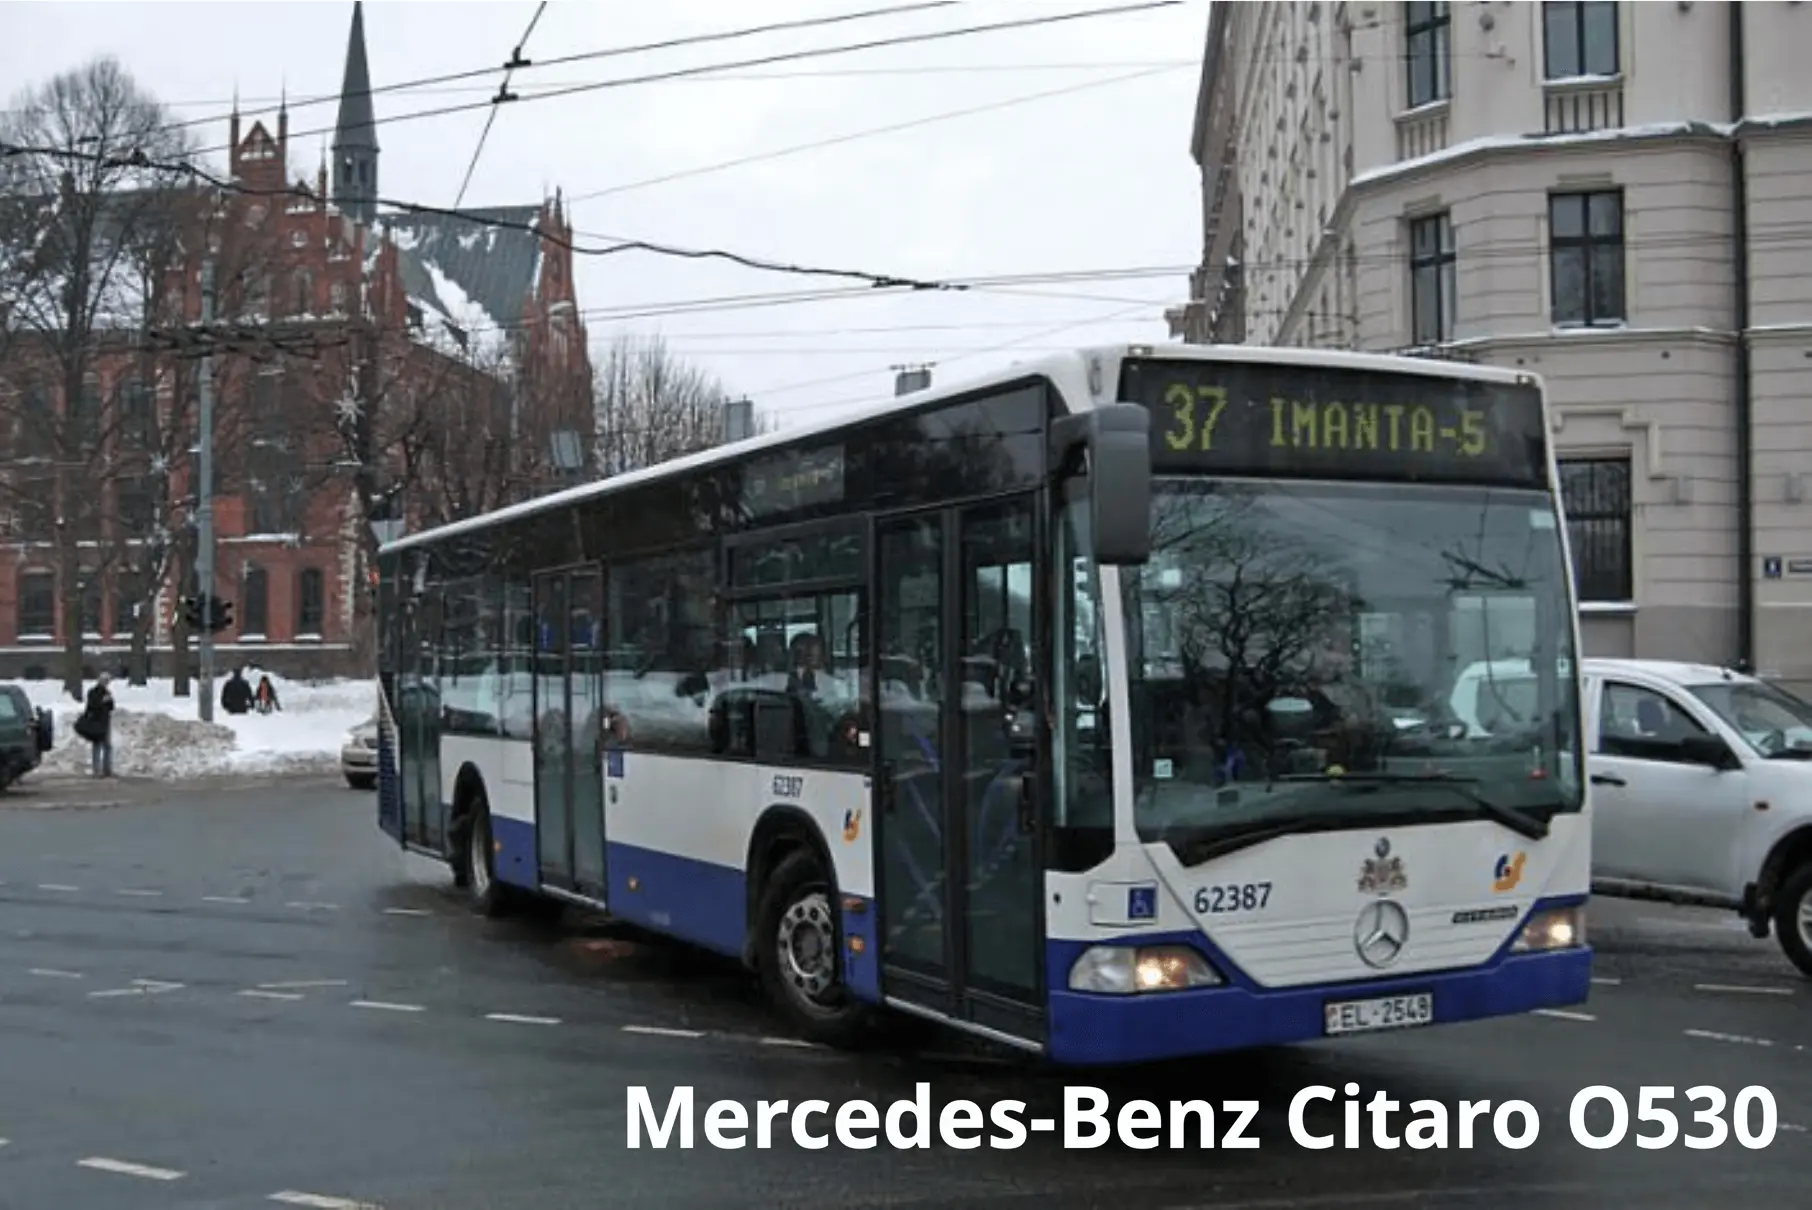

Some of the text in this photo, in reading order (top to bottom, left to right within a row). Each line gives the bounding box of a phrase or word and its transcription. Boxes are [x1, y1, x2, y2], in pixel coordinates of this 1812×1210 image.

[1164, 384, 1486, 455] 37 IMANTA-5
[1194, 882, 1272, 914] 62387
